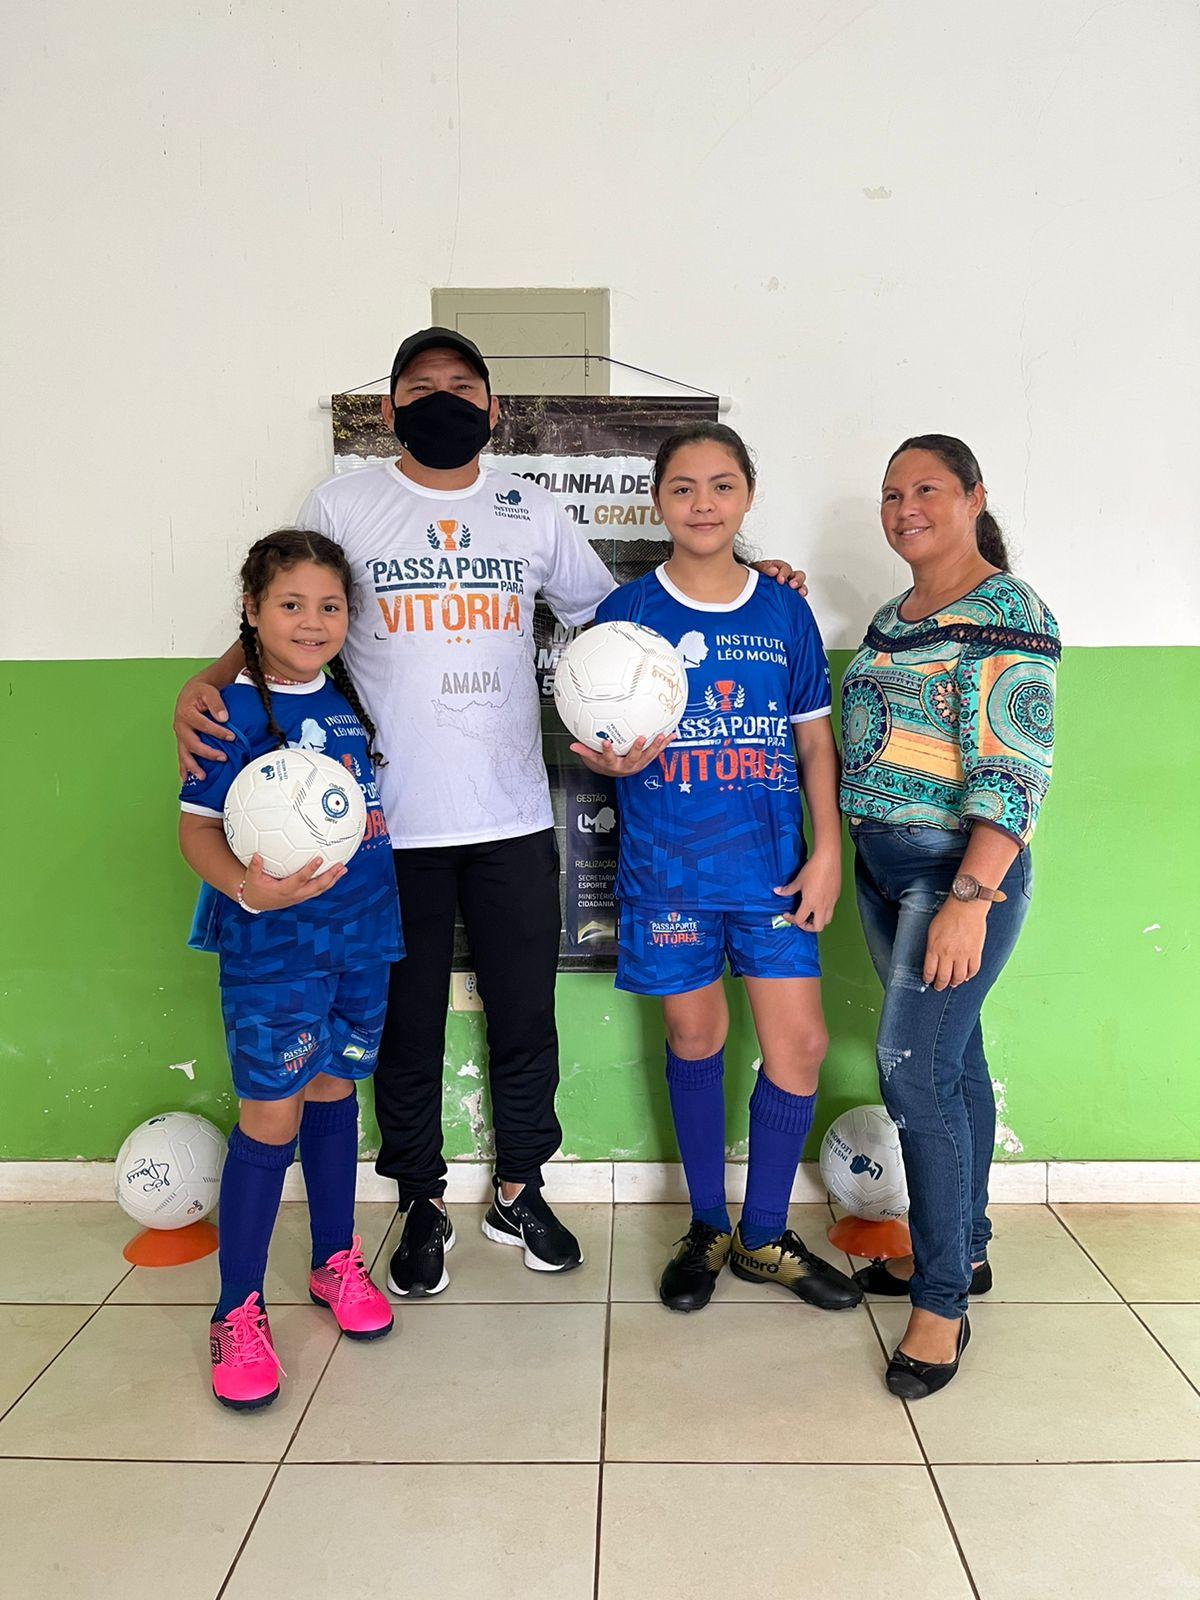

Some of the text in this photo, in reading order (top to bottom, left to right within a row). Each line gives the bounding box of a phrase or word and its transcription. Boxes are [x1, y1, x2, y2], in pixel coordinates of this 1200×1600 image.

[619, 474, 650, 494] DE
[500, 580, 524, 595] PARA
[377, 582, 521, 634] VITÓRIA
[717, 649, 788, 668] LÉO MOURA
[441, 666, 501, 695] AMAPÁ
[576, 792, 607, 803] GESTÃO
[575, 860, 617, 872] REALIZAÇÃO
